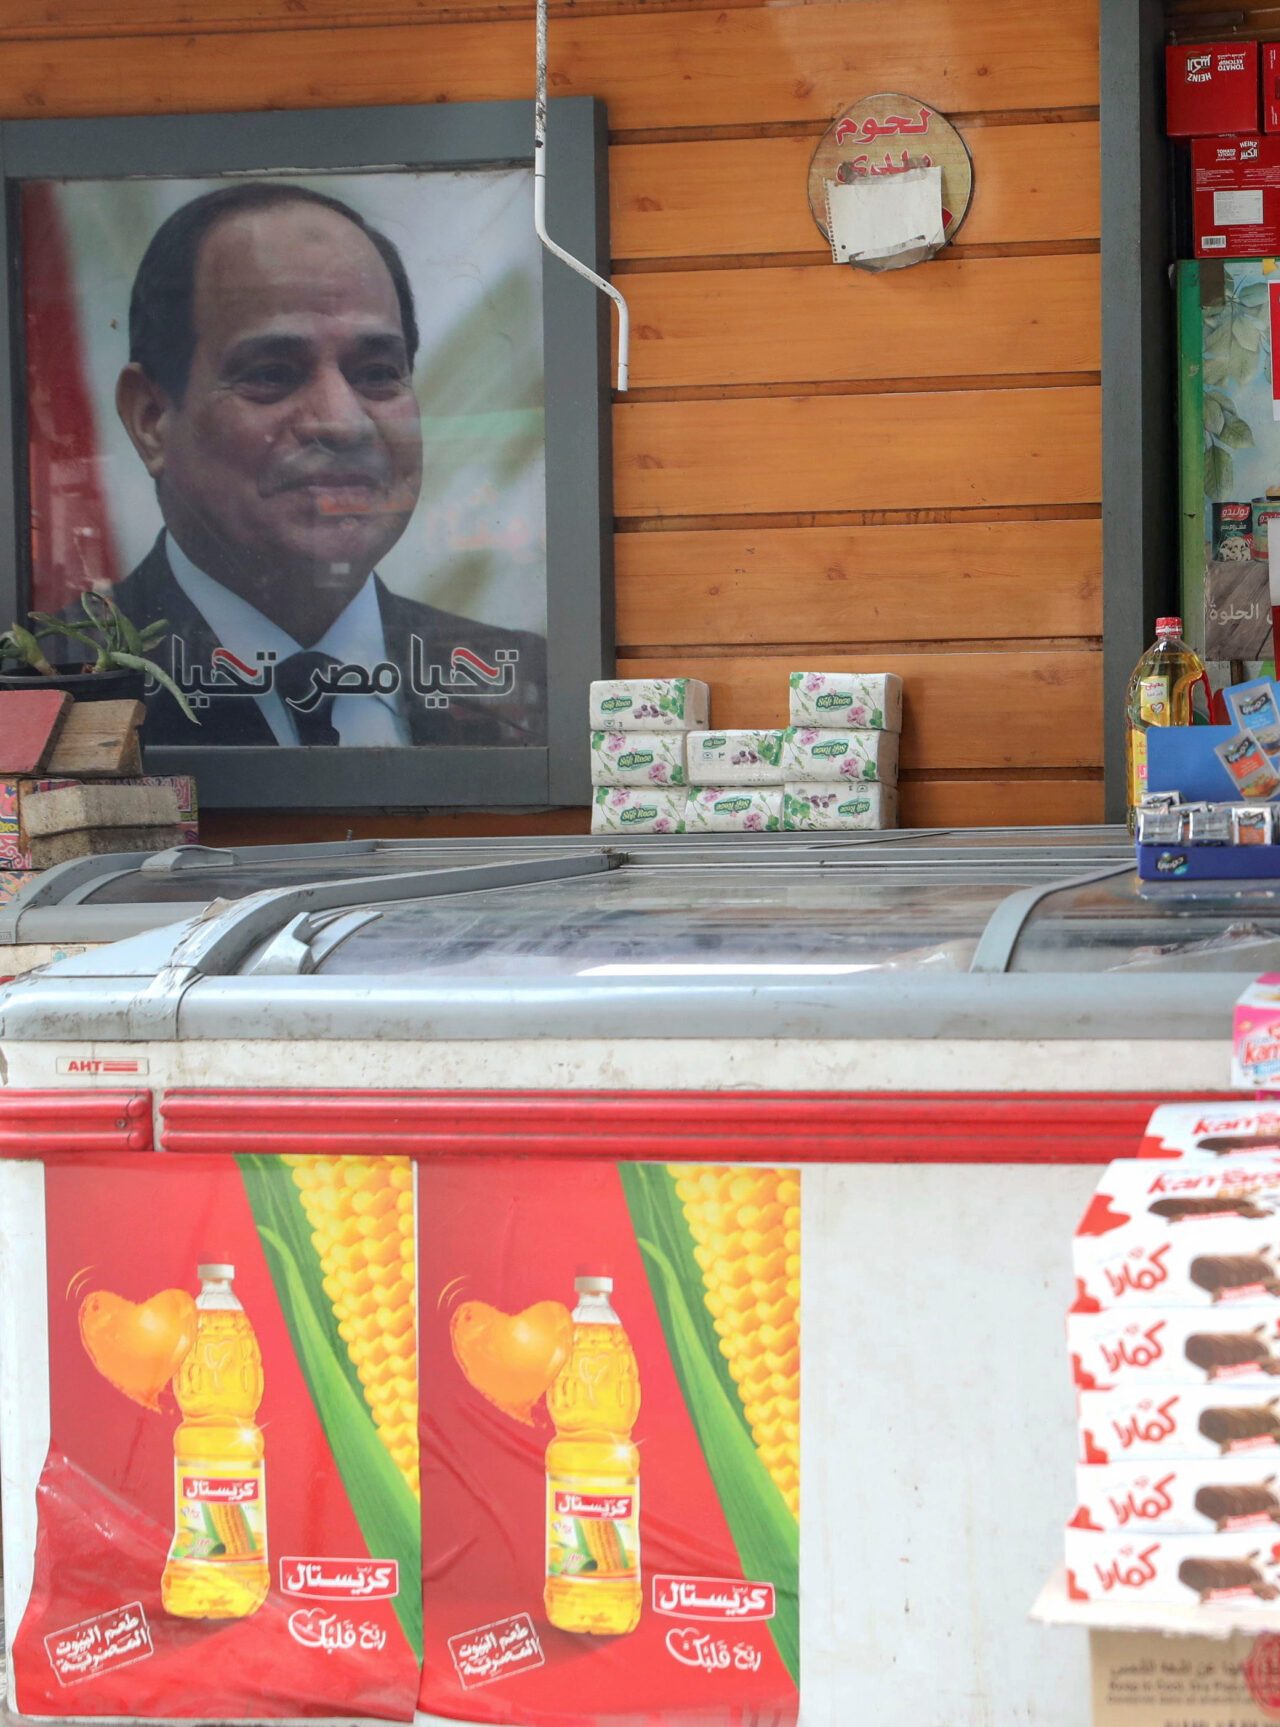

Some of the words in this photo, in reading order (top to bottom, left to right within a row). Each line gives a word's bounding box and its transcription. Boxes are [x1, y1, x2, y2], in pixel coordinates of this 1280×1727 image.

[1186, 72, 1213, 83] HEINZ
[836, 108, 932, 145] لحوم
[1239, 141, 1258, 149] HEINZ
[1208, 604, 1260, 626] الحلوة
[410, 634, 519, 709] تحيا
[286, 662, 401, 713] مصر
[68, 1060, 102, 1072] AHT
[186, 1480, 255, 1501] كريستال
[558, 1492, 630, 1518] كريستال
[286, 1562, 392, 1596] كريستال
[659, 1581, 768, 1615] كريستال
